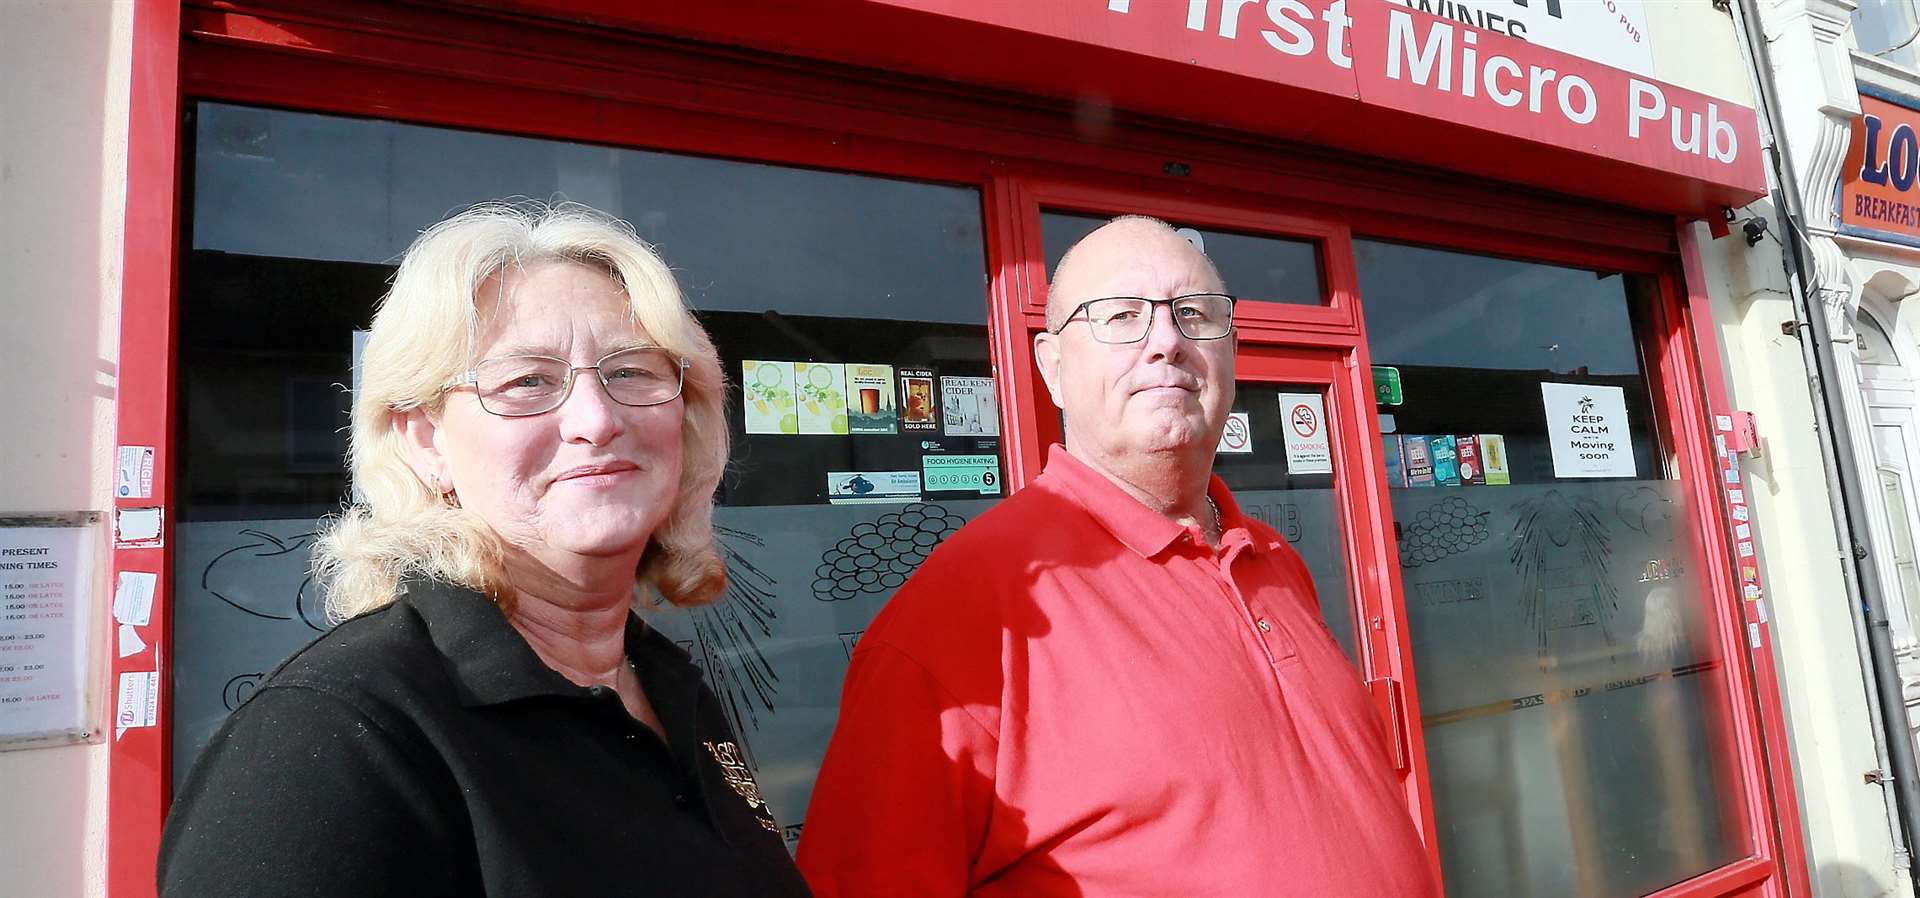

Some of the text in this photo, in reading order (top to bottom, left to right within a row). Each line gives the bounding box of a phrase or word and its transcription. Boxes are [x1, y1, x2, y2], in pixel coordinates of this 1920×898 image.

[1403, 0, 1527, 40] INES
[1619, 14, 1641, 43] PUB
[1107, 0, 1738, 165] rst Micro Pub
[1860, 114, 1920, 192] LO
[945, 379, 993, 388] REAL KENT
[945, 387, 974, 395] CIDER
[1572, 415, 1604, 424] KEEP
[1570, 425, 1609, 434] CALM
[1570, 440, 1615, 452] Moving
[2, 548, 49, 556] PRESENT
[27, 561, 58, 569] TIMES
